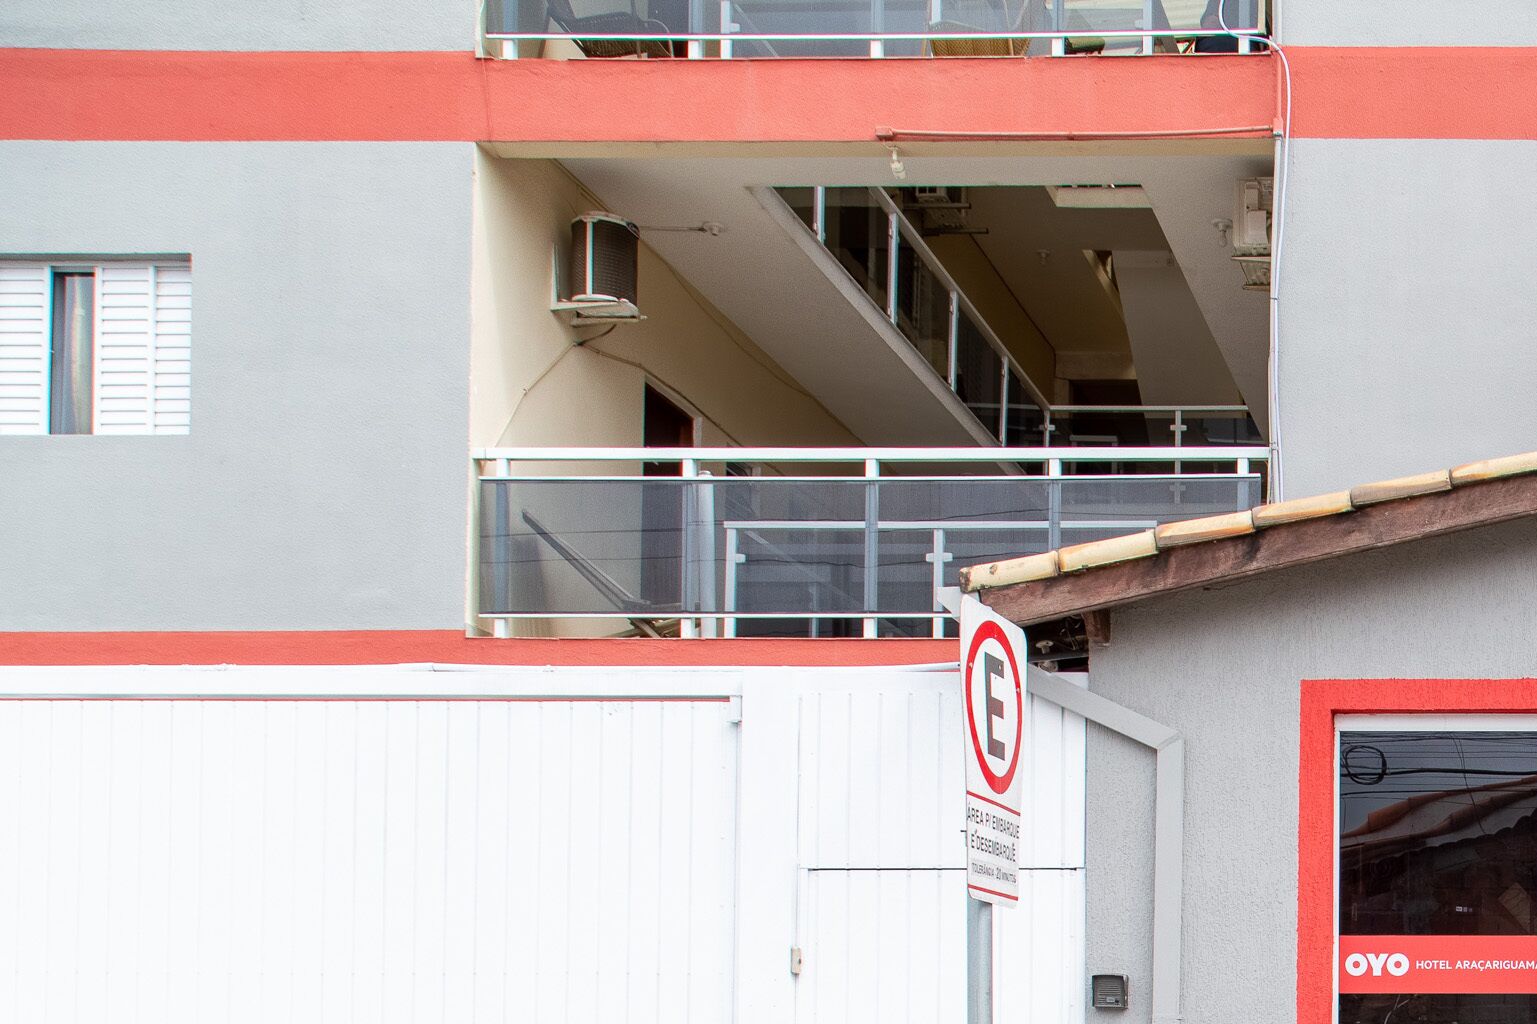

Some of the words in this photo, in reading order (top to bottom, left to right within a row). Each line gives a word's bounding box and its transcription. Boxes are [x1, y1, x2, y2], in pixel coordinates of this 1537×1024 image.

[985, 651, 1006, 762] E
[967, 802, 984, 826] ÁREA
[992, 815, 1020, 839] EMBARQUE
[976, 835, 1016, 863] DESEMBARQUE
[1344, 953, 1409, 977] OYO
[1415, 960, 1452, 970] HOTEL
